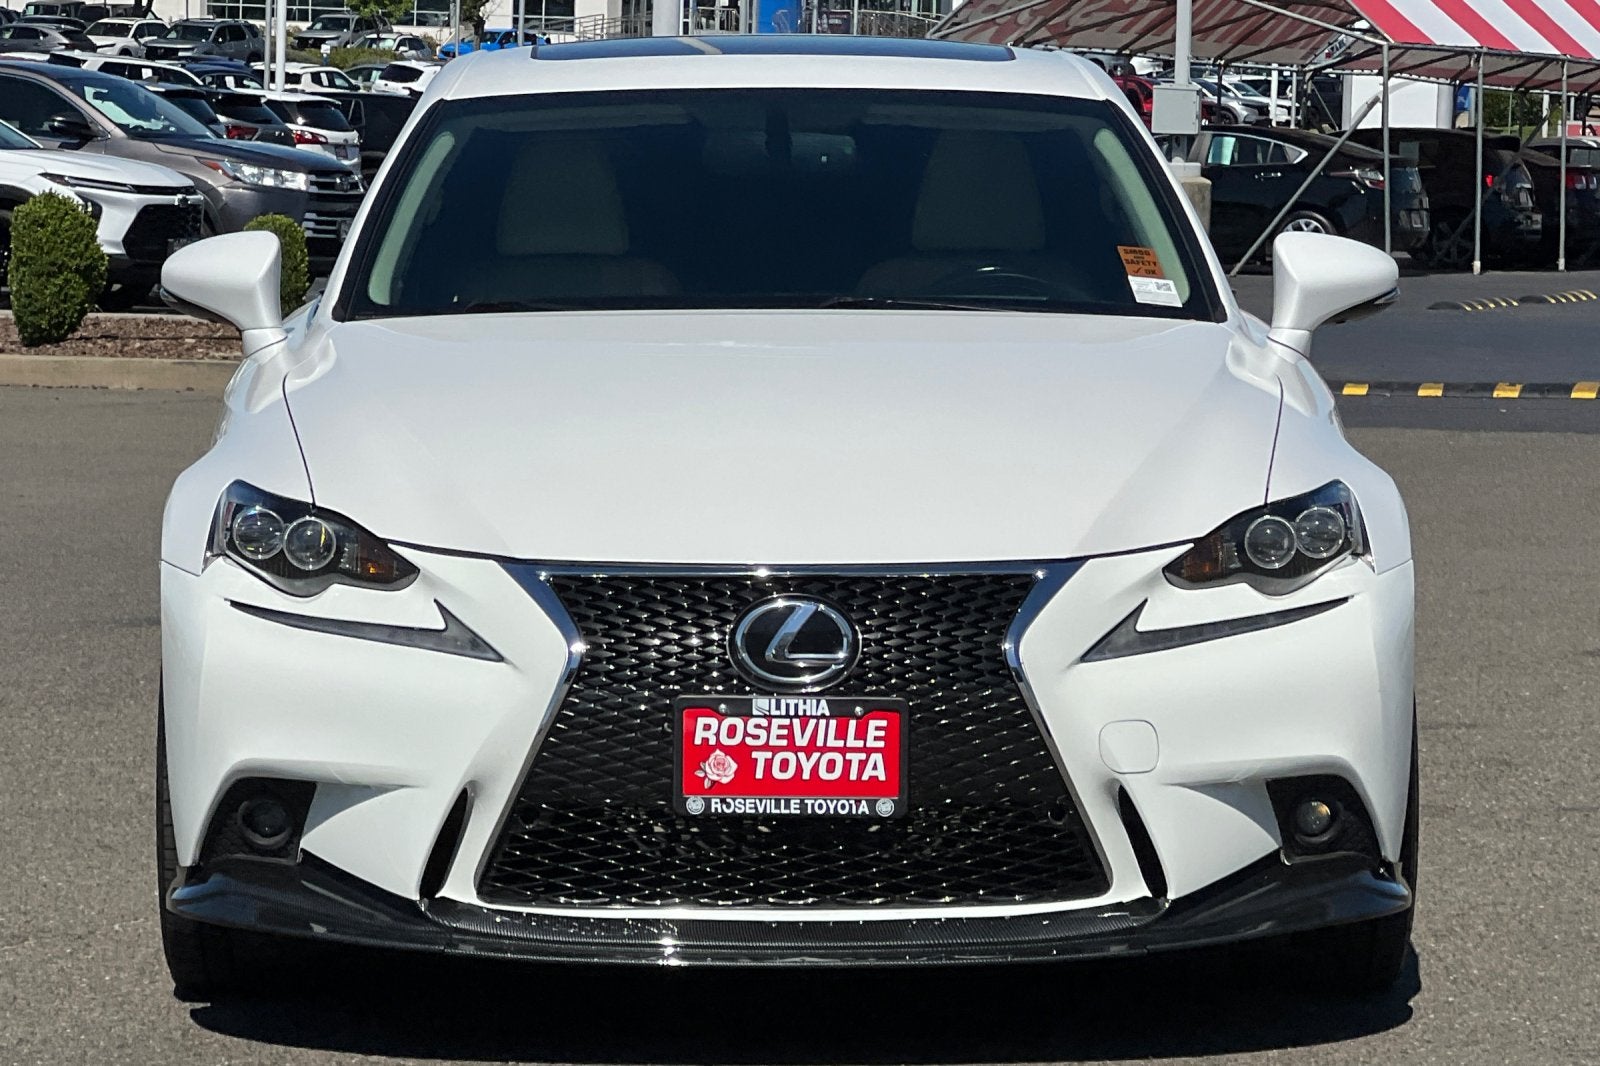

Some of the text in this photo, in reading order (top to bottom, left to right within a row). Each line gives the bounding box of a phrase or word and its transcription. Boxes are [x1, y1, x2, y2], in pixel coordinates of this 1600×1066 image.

[1125, 259, 1157, 267] SAFETY
[770, 698, 830, 716] LITHIA
[693, 716, 888, 748] ROSEVILLE
[751, 751, 887, 781] TOYOTA
[710, 798, 870, 815] ROSEVILLE TOYOTA
